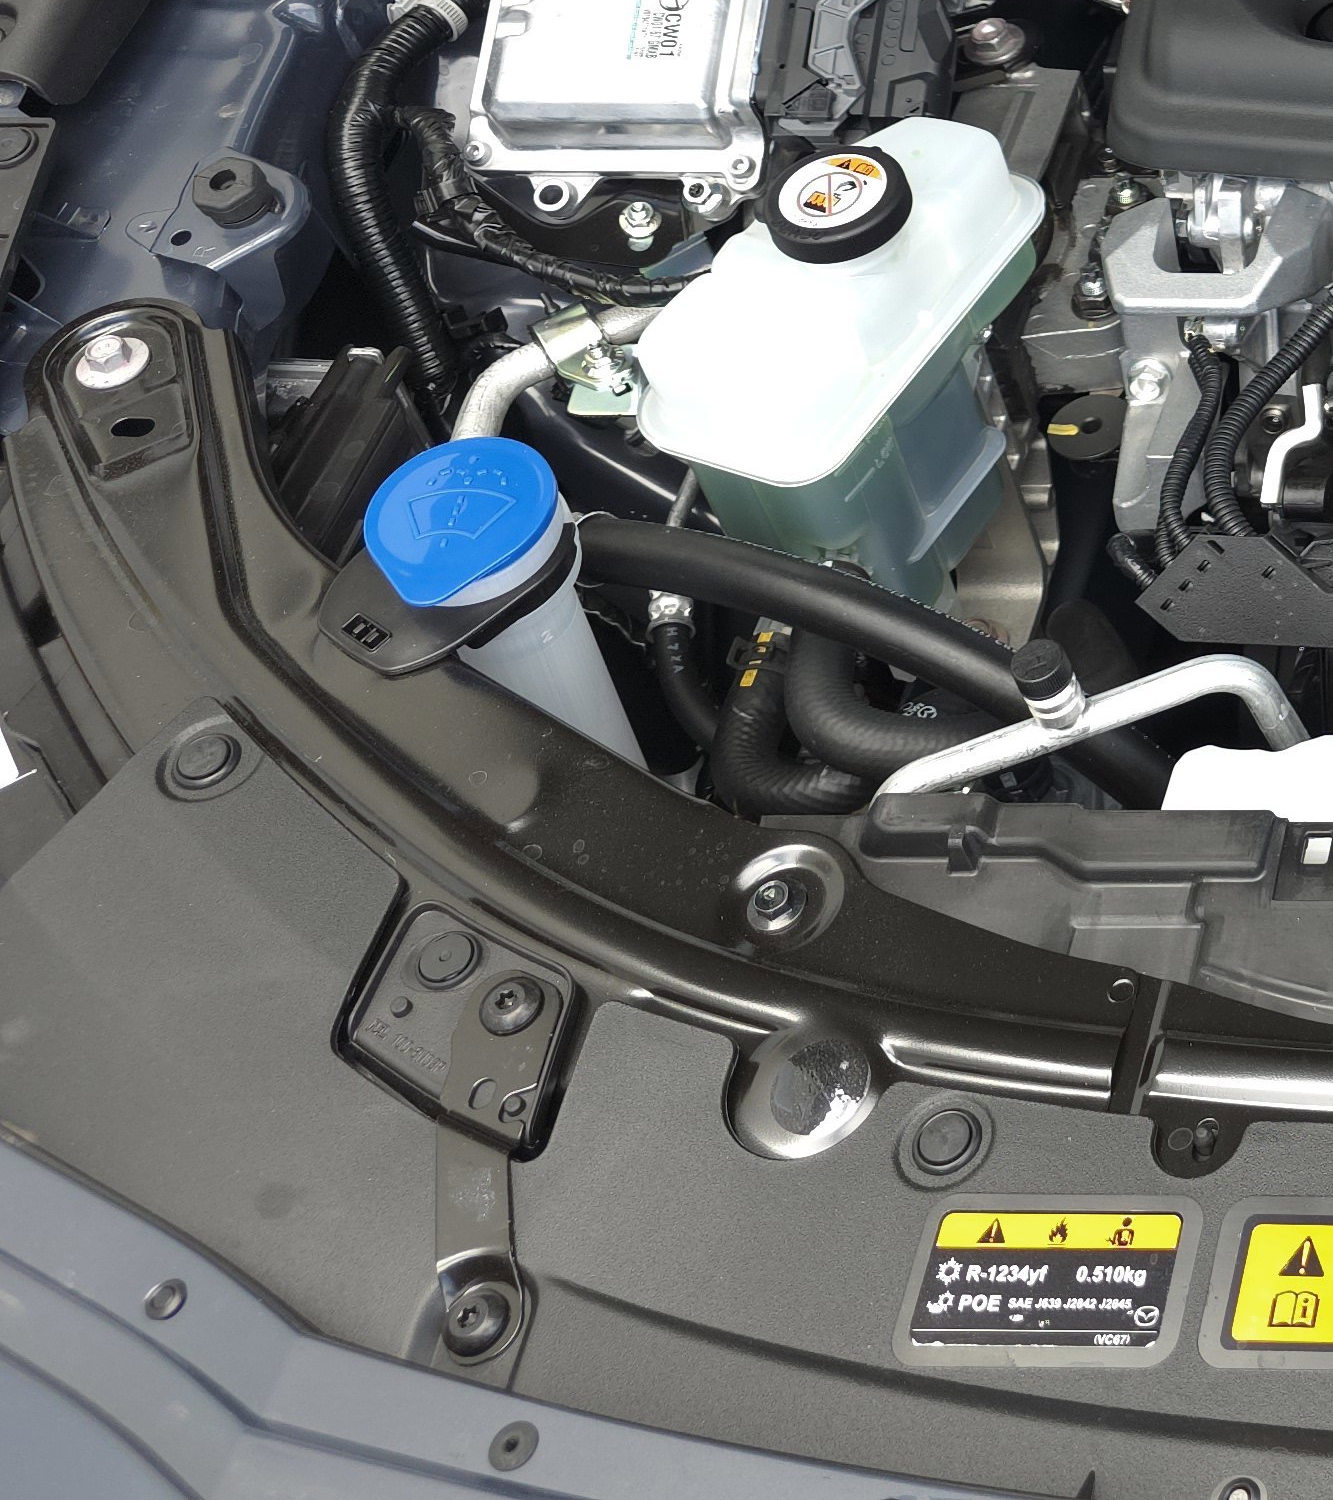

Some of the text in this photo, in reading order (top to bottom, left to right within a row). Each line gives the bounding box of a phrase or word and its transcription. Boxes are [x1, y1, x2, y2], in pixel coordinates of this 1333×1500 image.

[659, 13, 682, 57] CW01
[966, 1263, 1147, 1287] R-1234yf 0.510kg
[957, 1293, 1001, 1313] POE
[1007, 1298, 1032, 1310] SAE
[1034, 1297, 1061, 1310] J639
[1093, 1332, 1131, 1347] (VC67)
